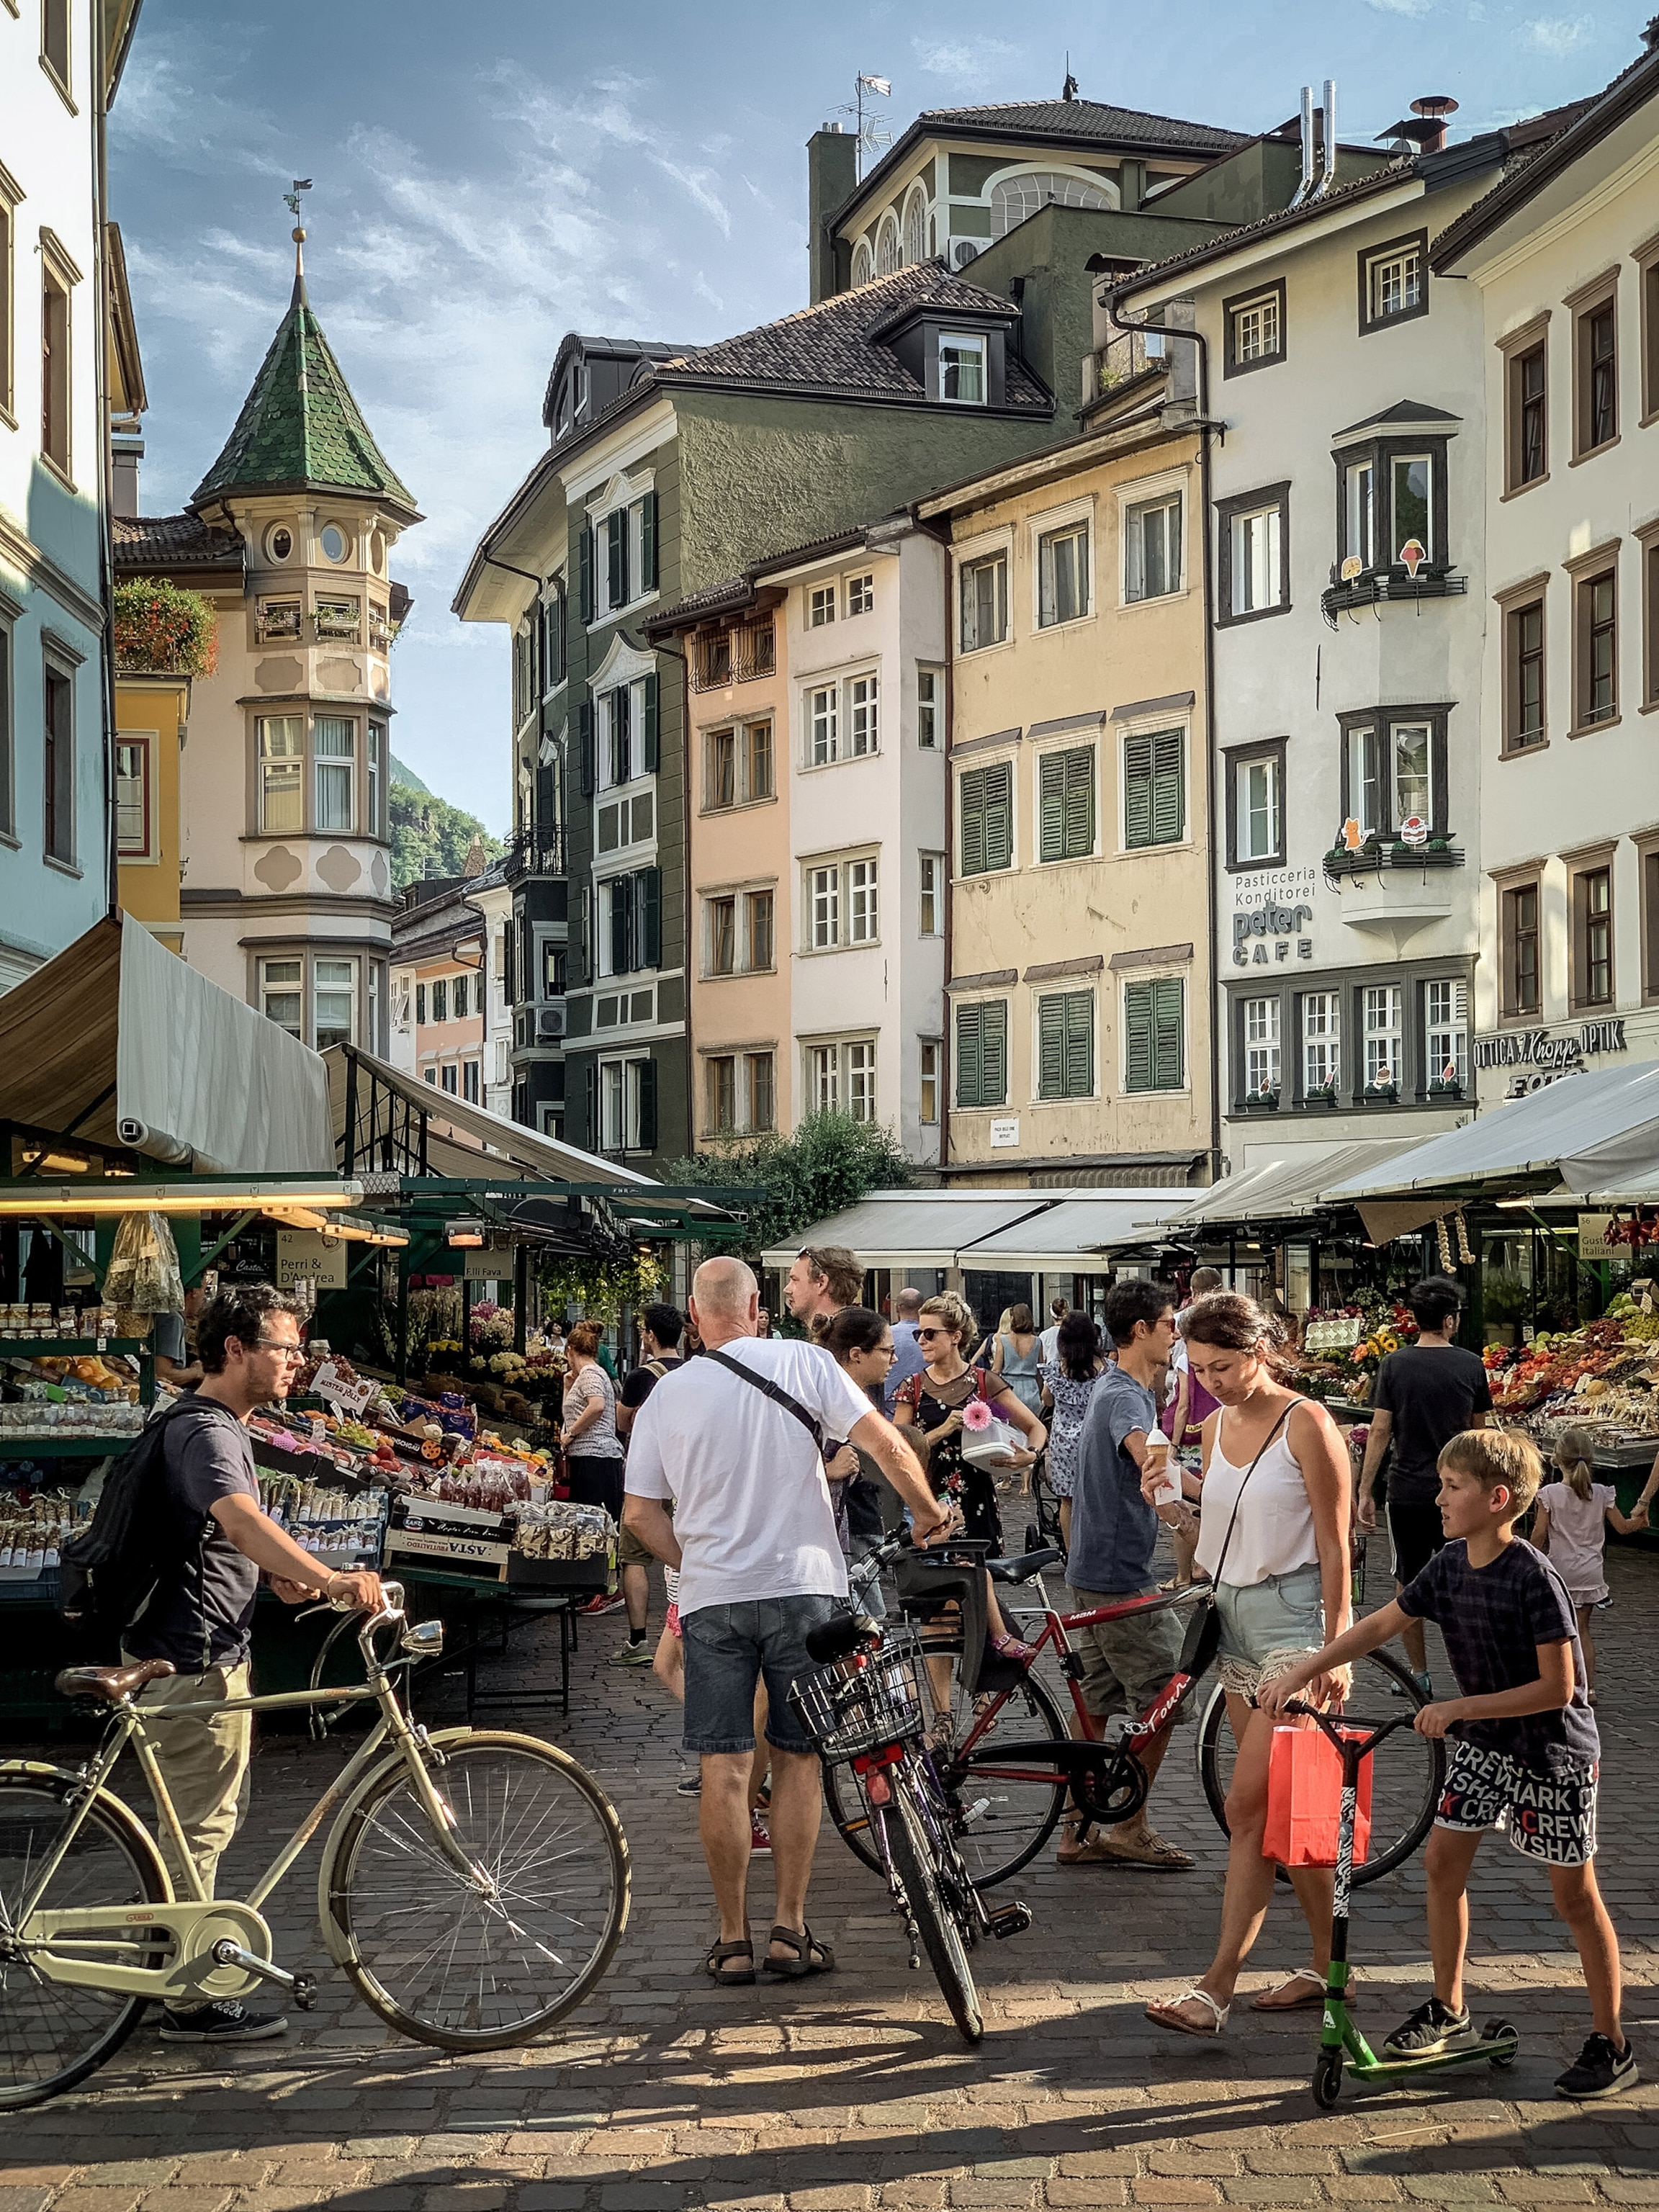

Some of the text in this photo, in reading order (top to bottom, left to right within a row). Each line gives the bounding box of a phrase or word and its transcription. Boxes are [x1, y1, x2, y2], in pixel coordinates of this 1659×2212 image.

[1236, 867, 1315, 889] Pasticceria
[1236, 883, 1315, 906] Konditorei
[1233, 901, 1312, 947] peter
[1233, 939, 1312, 966] CAFE
[1473, 1036, 1516, 1068] OTTICA
[1580, 1020, 1623, 1054] OPTIK
[282, 1234, 293, 1243] 42
[1582, 1236, 1605, 1245] Gust
[281, 1258, 322, 1269] Perri &
[482, 1268, 502, 1277] Fava
[320, 1379, 344, 1393] MISTER
[405, 1519, 423, 1527] KANZI
[449, 1542, 487, 1555] ASTA
[1069, 1609, 1097, 1621] MBM
[1521, 1809, 1592, 1838] CREW
